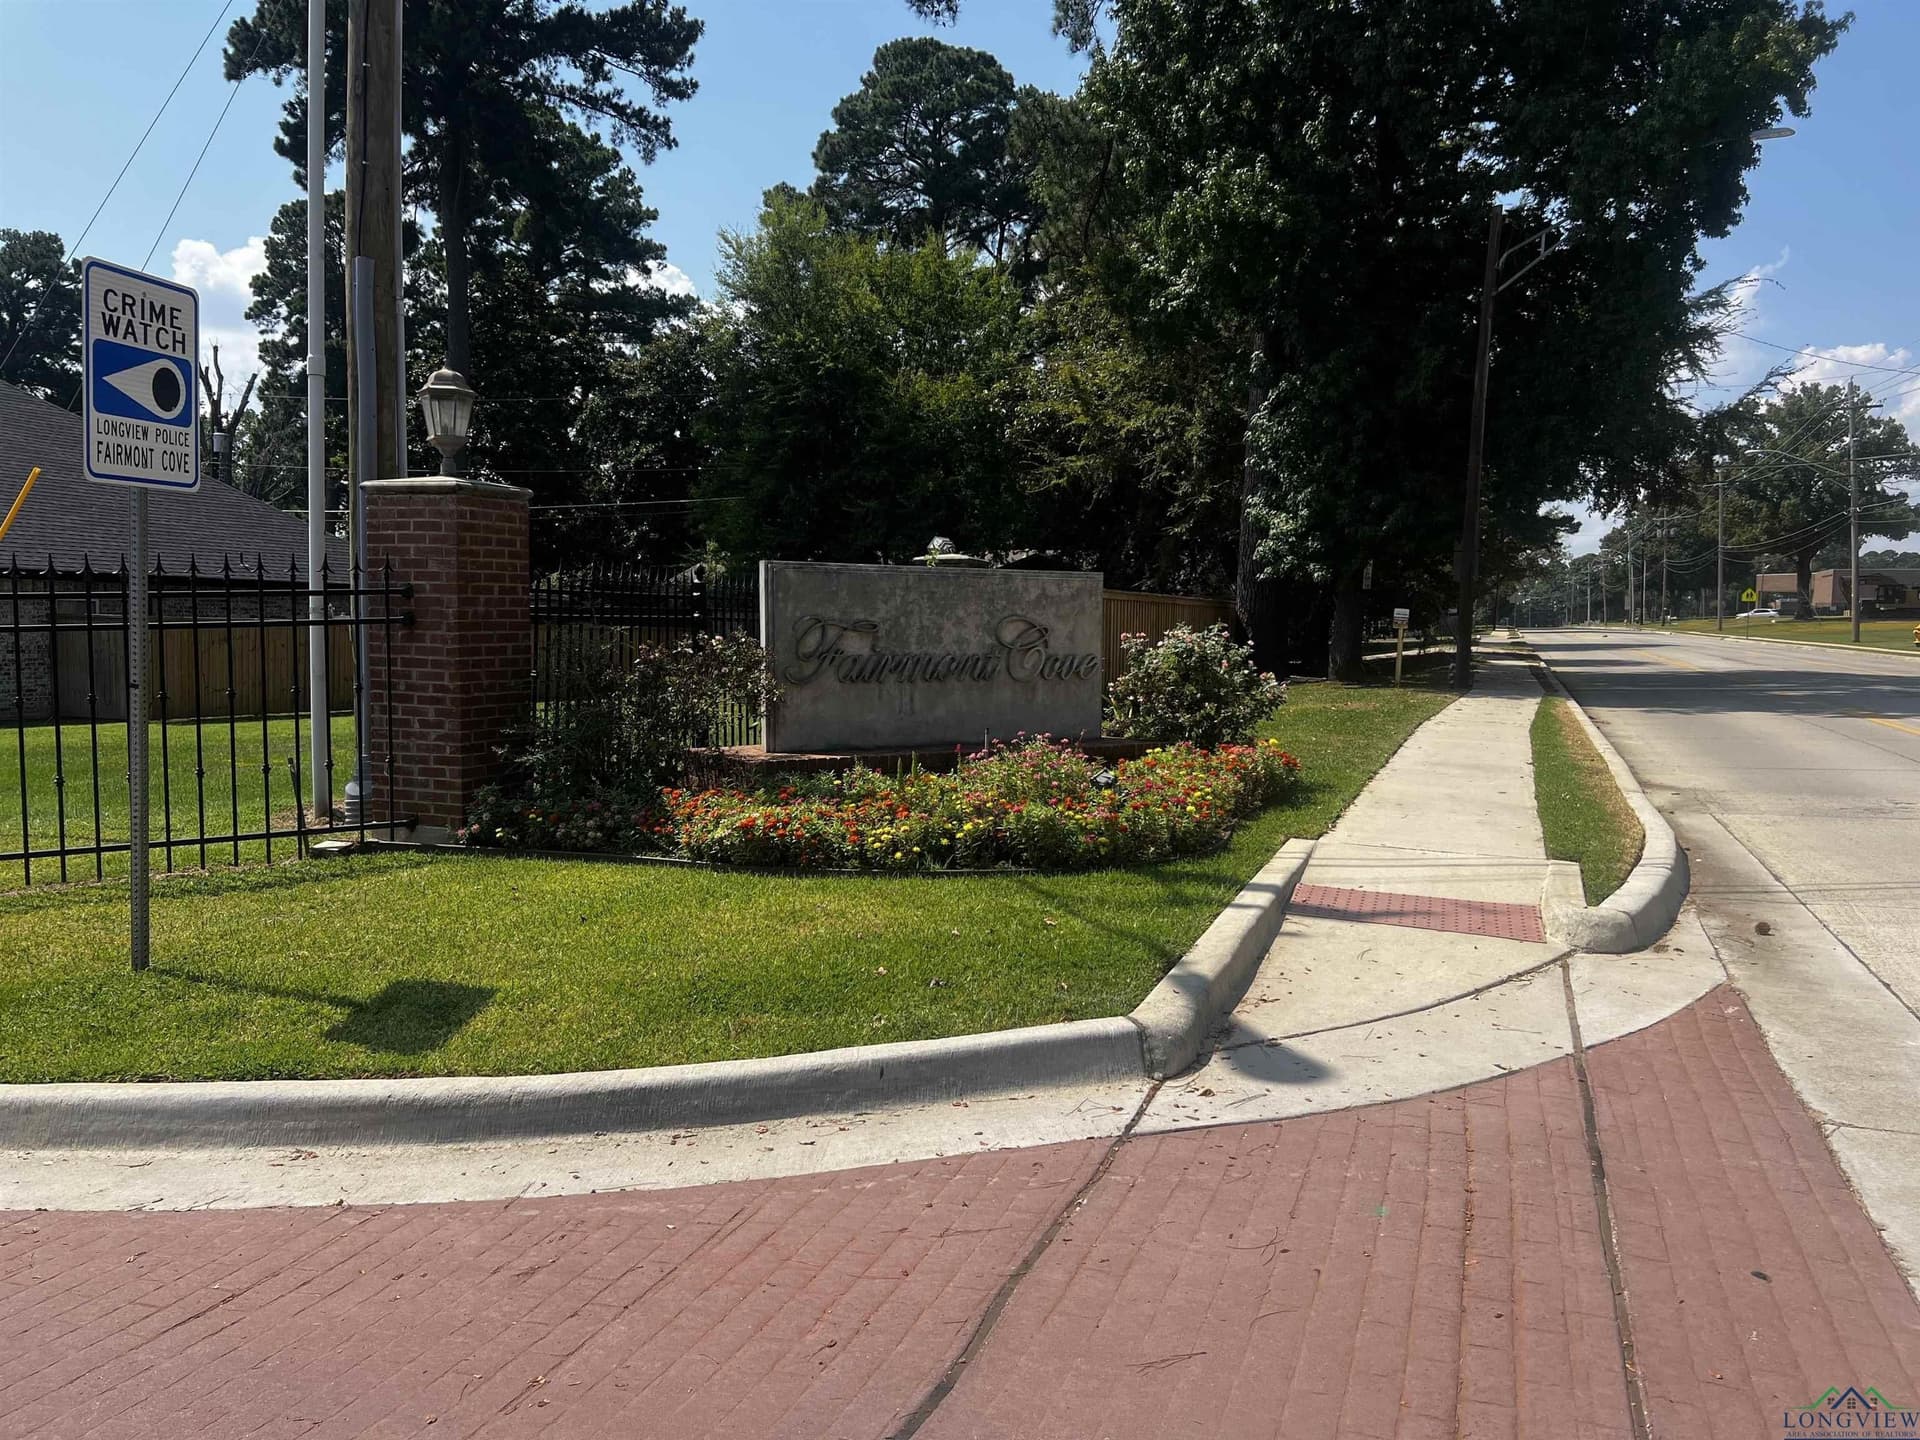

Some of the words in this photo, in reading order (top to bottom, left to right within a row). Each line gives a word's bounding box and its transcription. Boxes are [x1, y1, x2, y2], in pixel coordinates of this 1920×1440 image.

[103, 288, 182, 332] CRIME
[101, 311, 186, 355] WATCH
[96, 418, 149, 442] LONGVIEW
[155, 427, 190, 448] POLICE
[97, 441, 154, 470] FAIRMONT
[161, 450, 190, 474] COVE
[784, 615, 1000, 685] Fairmont
[995, 614, 1099, 683] Cove
